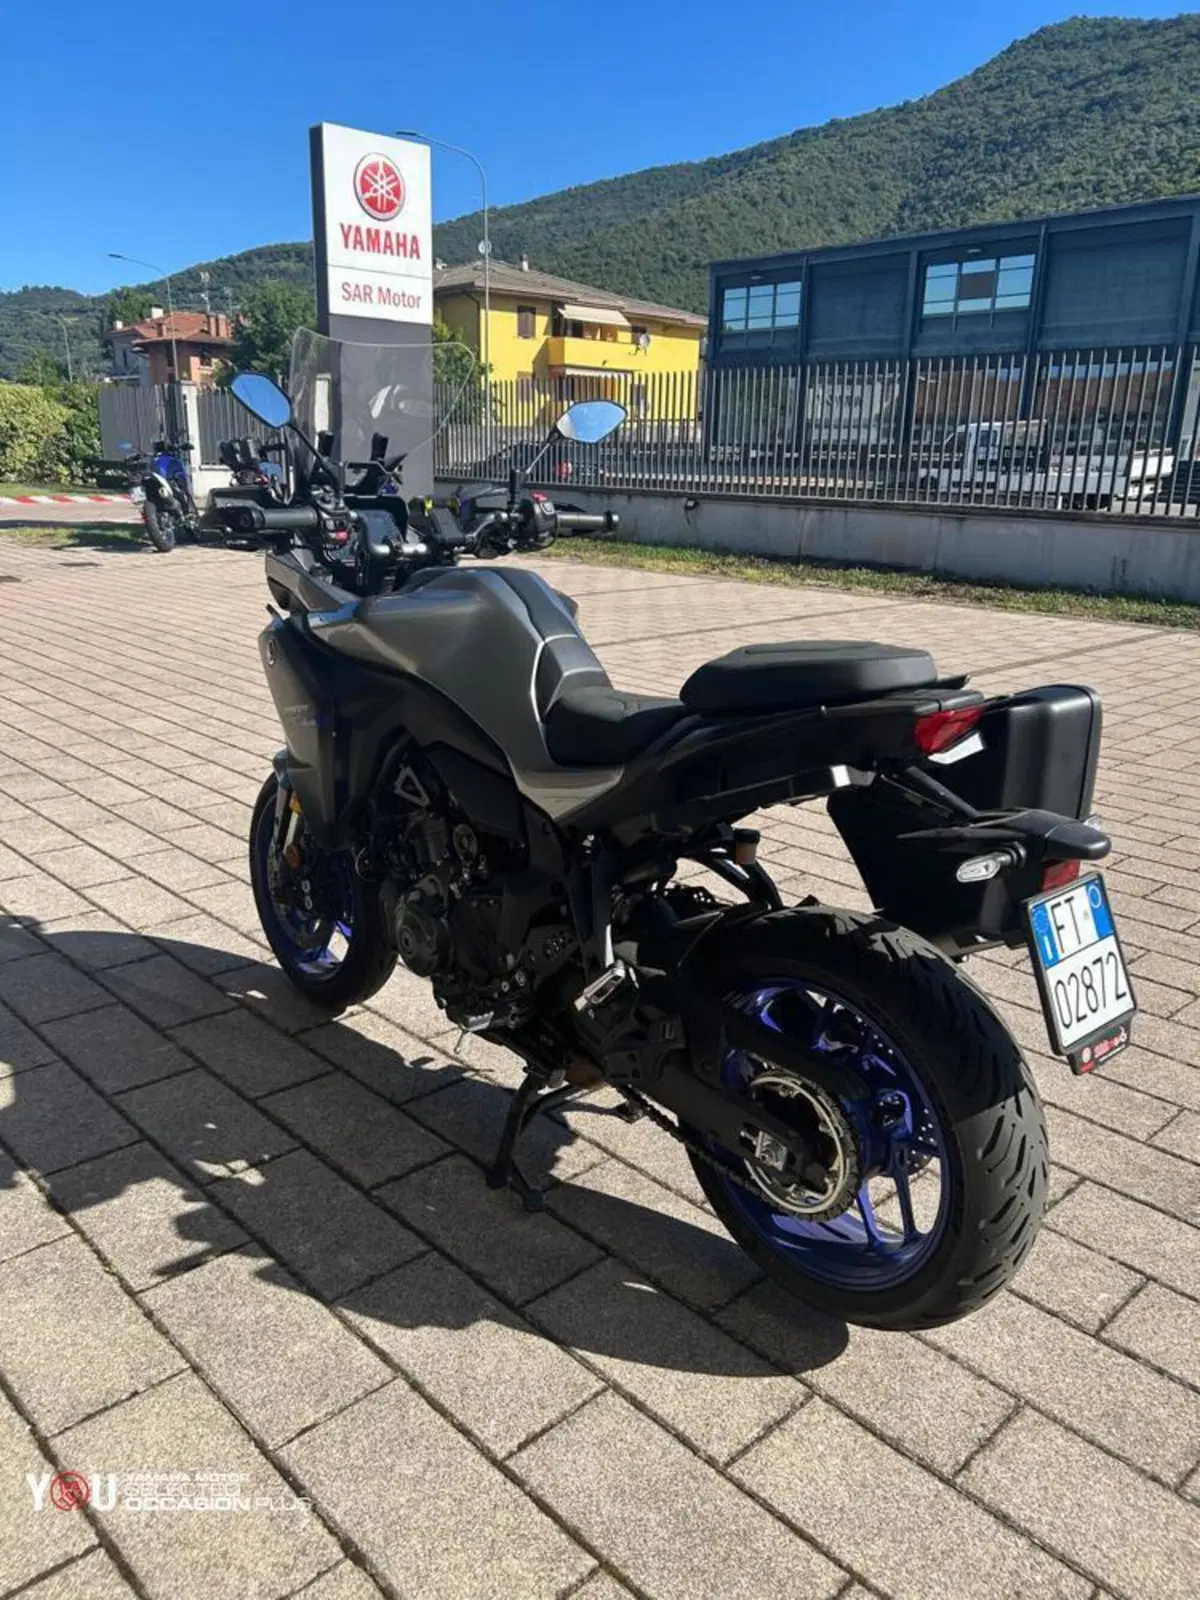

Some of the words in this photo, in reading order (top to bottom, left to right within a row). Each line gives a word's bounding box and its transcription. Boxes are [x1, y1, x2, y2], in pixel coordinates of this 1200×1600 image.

[339, 222, 421, 260] YAMAHA
[341, 281, 373, 304] SAR
[377, 285, 422, 308] Motor
[1050, 895, 1082, 954] FT
[1054, 951, 1127, 1029] 02872
